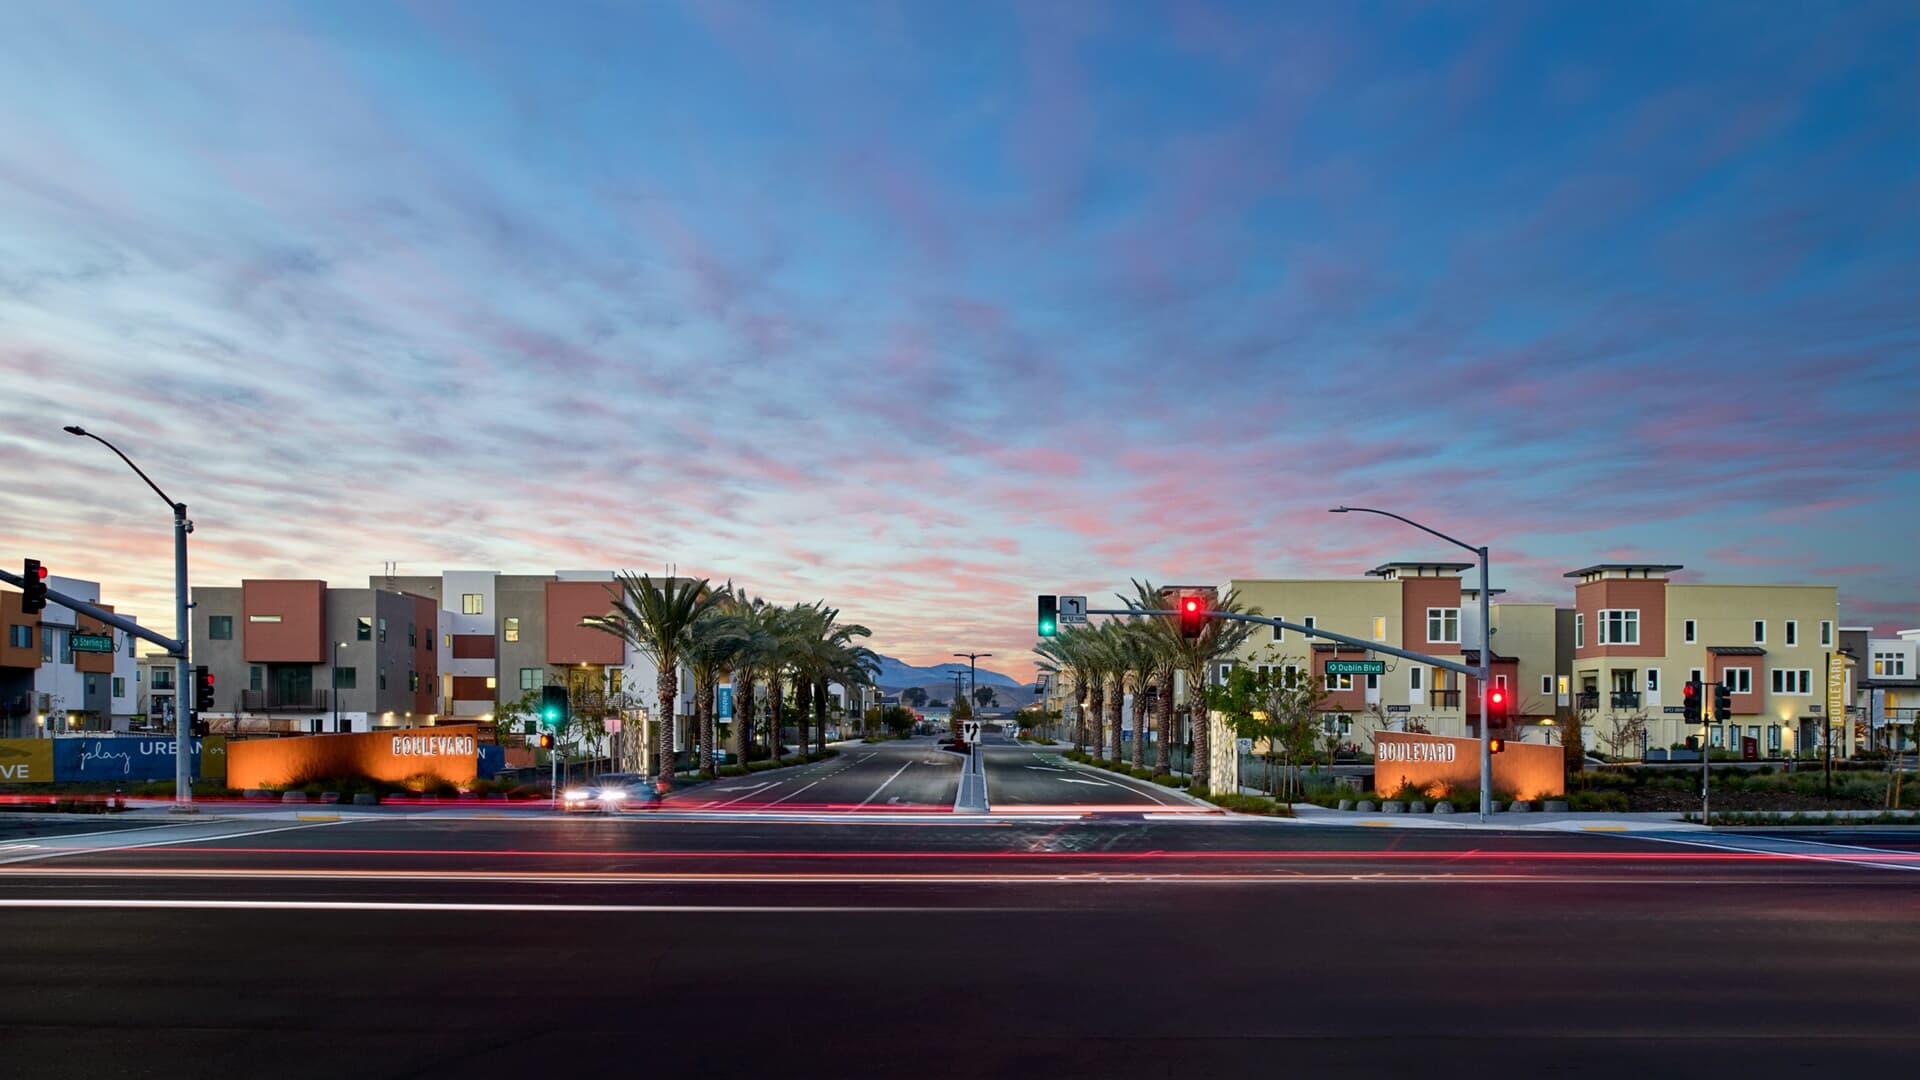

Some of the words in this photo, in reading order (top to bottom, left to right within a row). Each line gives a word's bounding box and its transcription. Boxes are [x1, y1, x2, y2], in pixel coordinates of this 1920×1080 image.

[79, 637, 103, 649] Sterling
[1338, 663, 1362, 672] Dublin
[1363, 663, 1381, 672] Blvd
[1830, 658, 1841, 722] BOULEVARD
[392, 735, 474, 757] BOULEVARD
[1378, 742, 1456, 763] BOULEVARD
[80, 741, 131, 774] play
